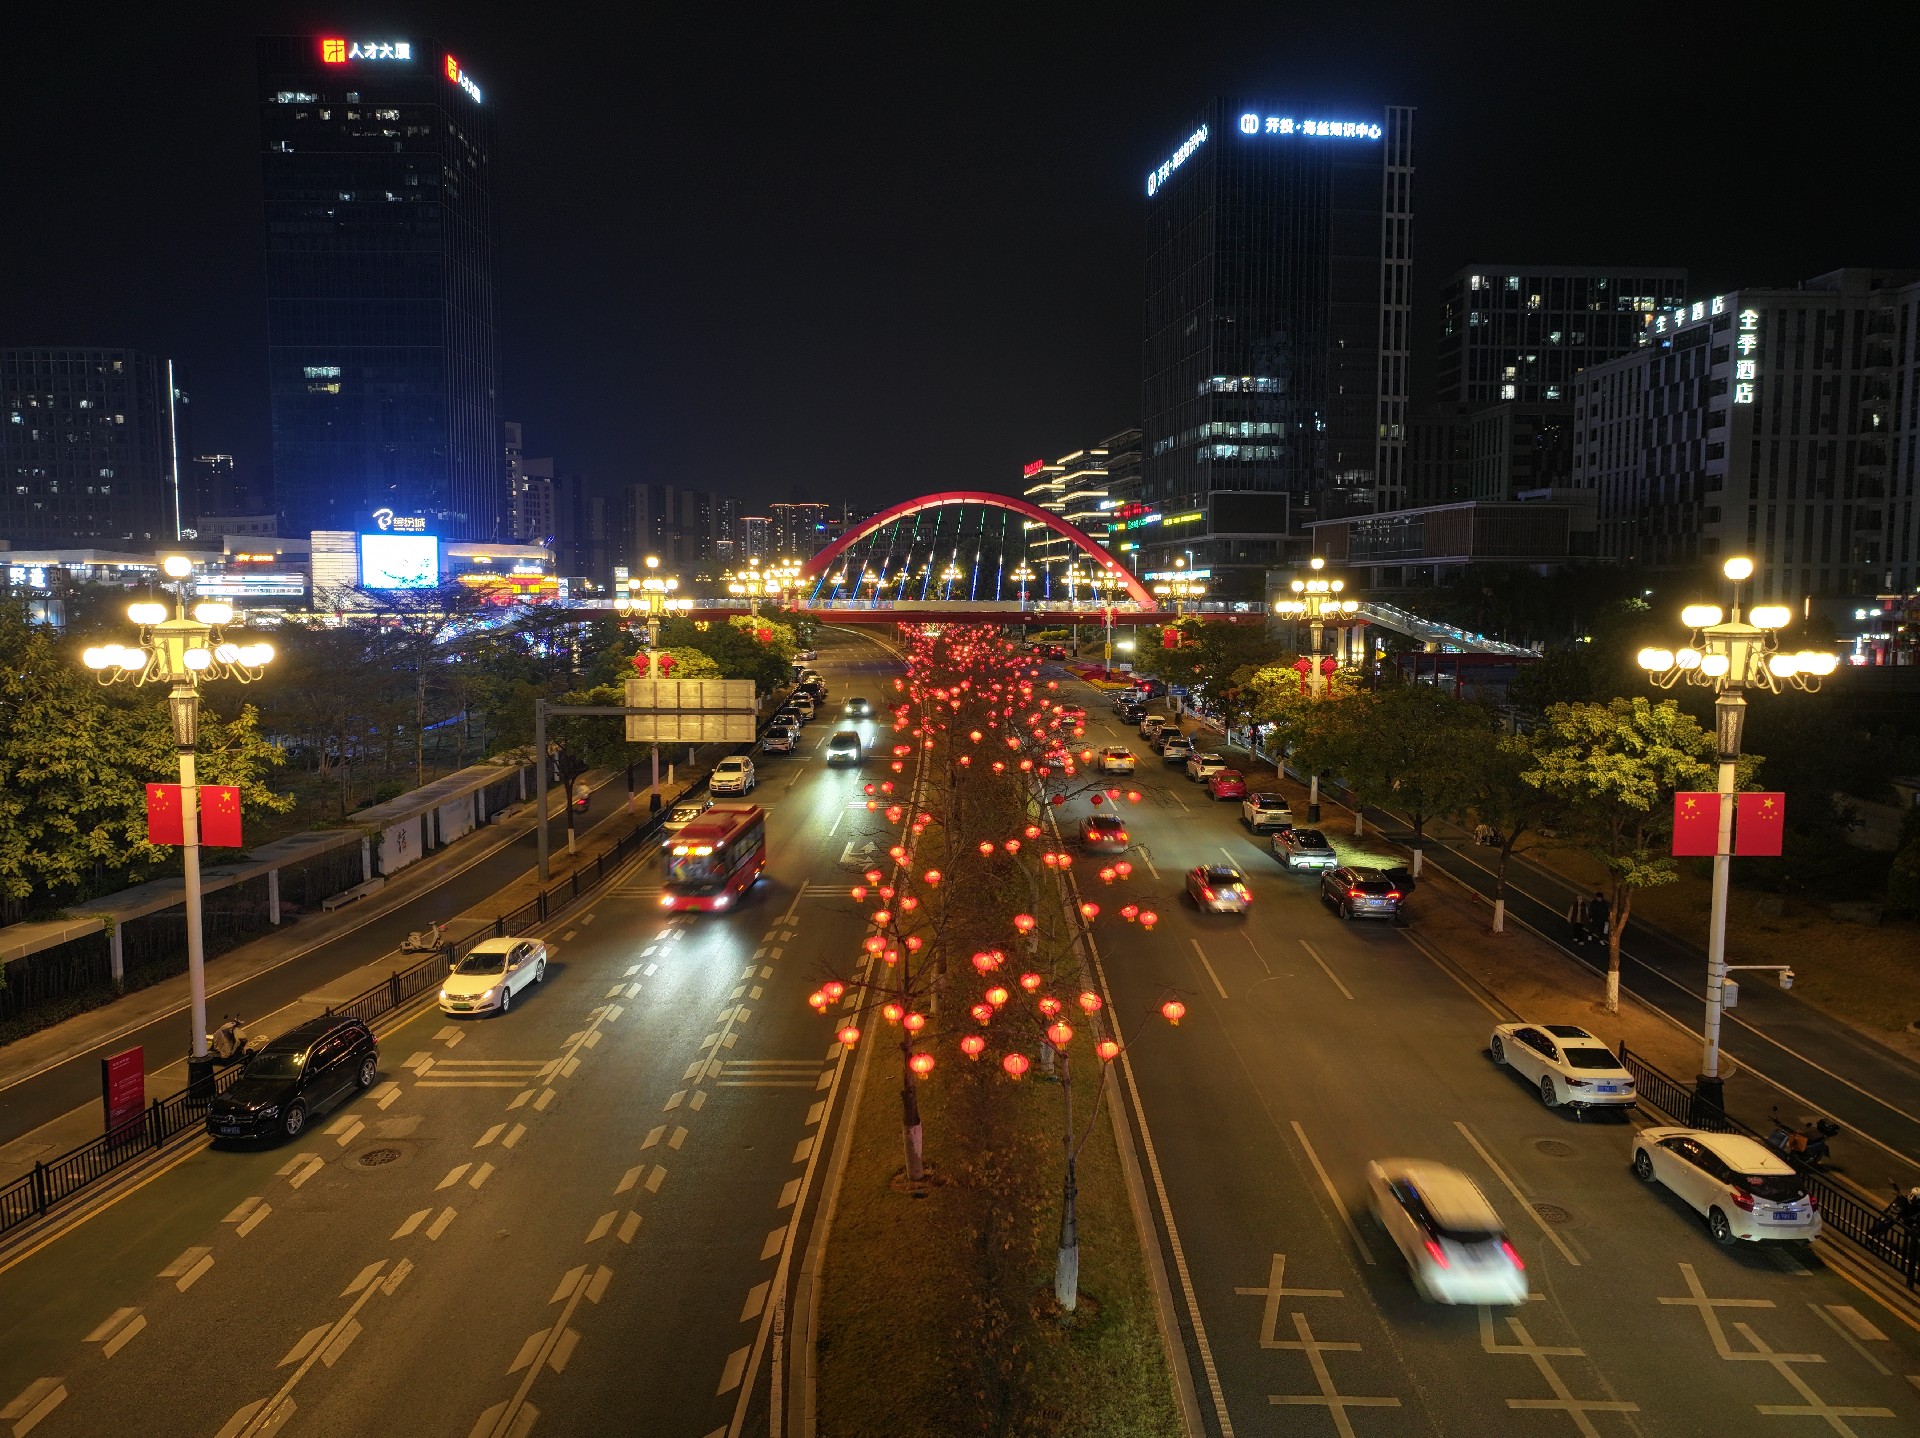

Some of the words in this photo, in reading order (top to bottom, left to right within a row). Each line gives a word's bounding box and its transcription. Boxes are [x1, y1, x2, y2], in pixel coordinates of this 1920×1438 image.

[348, 42, 411, 60] 人才大厦
[1656, 296, 1725, 334] 全季酒店
[1734, 309, 1759, 403] 全季酒店
